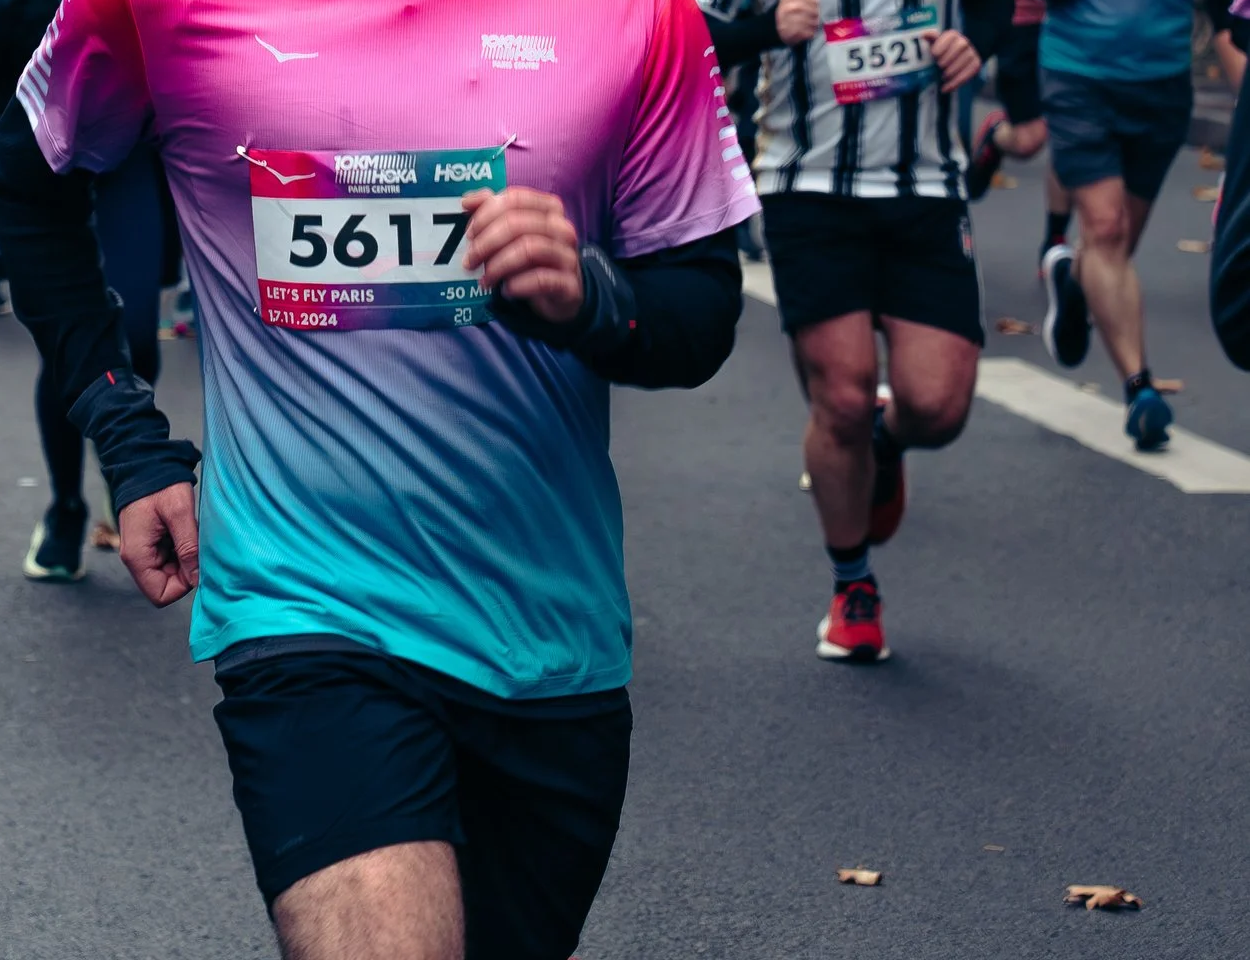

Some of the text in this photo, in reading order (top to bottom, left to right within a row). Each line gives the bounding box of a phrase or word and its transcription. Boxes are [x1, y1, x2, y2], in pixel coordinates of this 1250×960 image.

[847, 37, 923, 72] 5521
[334, 155, 378, 170] 10KM
[372, 169, 417, 184] HOKA
[434, 161, 493, 183] HOKA
[348, 184, 400, 194] PARIS CENTRE
[289, 213, 472, 268] 5617
[266, 286, 375, 303] LET'S FLY PARIS
[440, 286, 466, 300] -50
[454, 307, 472, 322] 20
